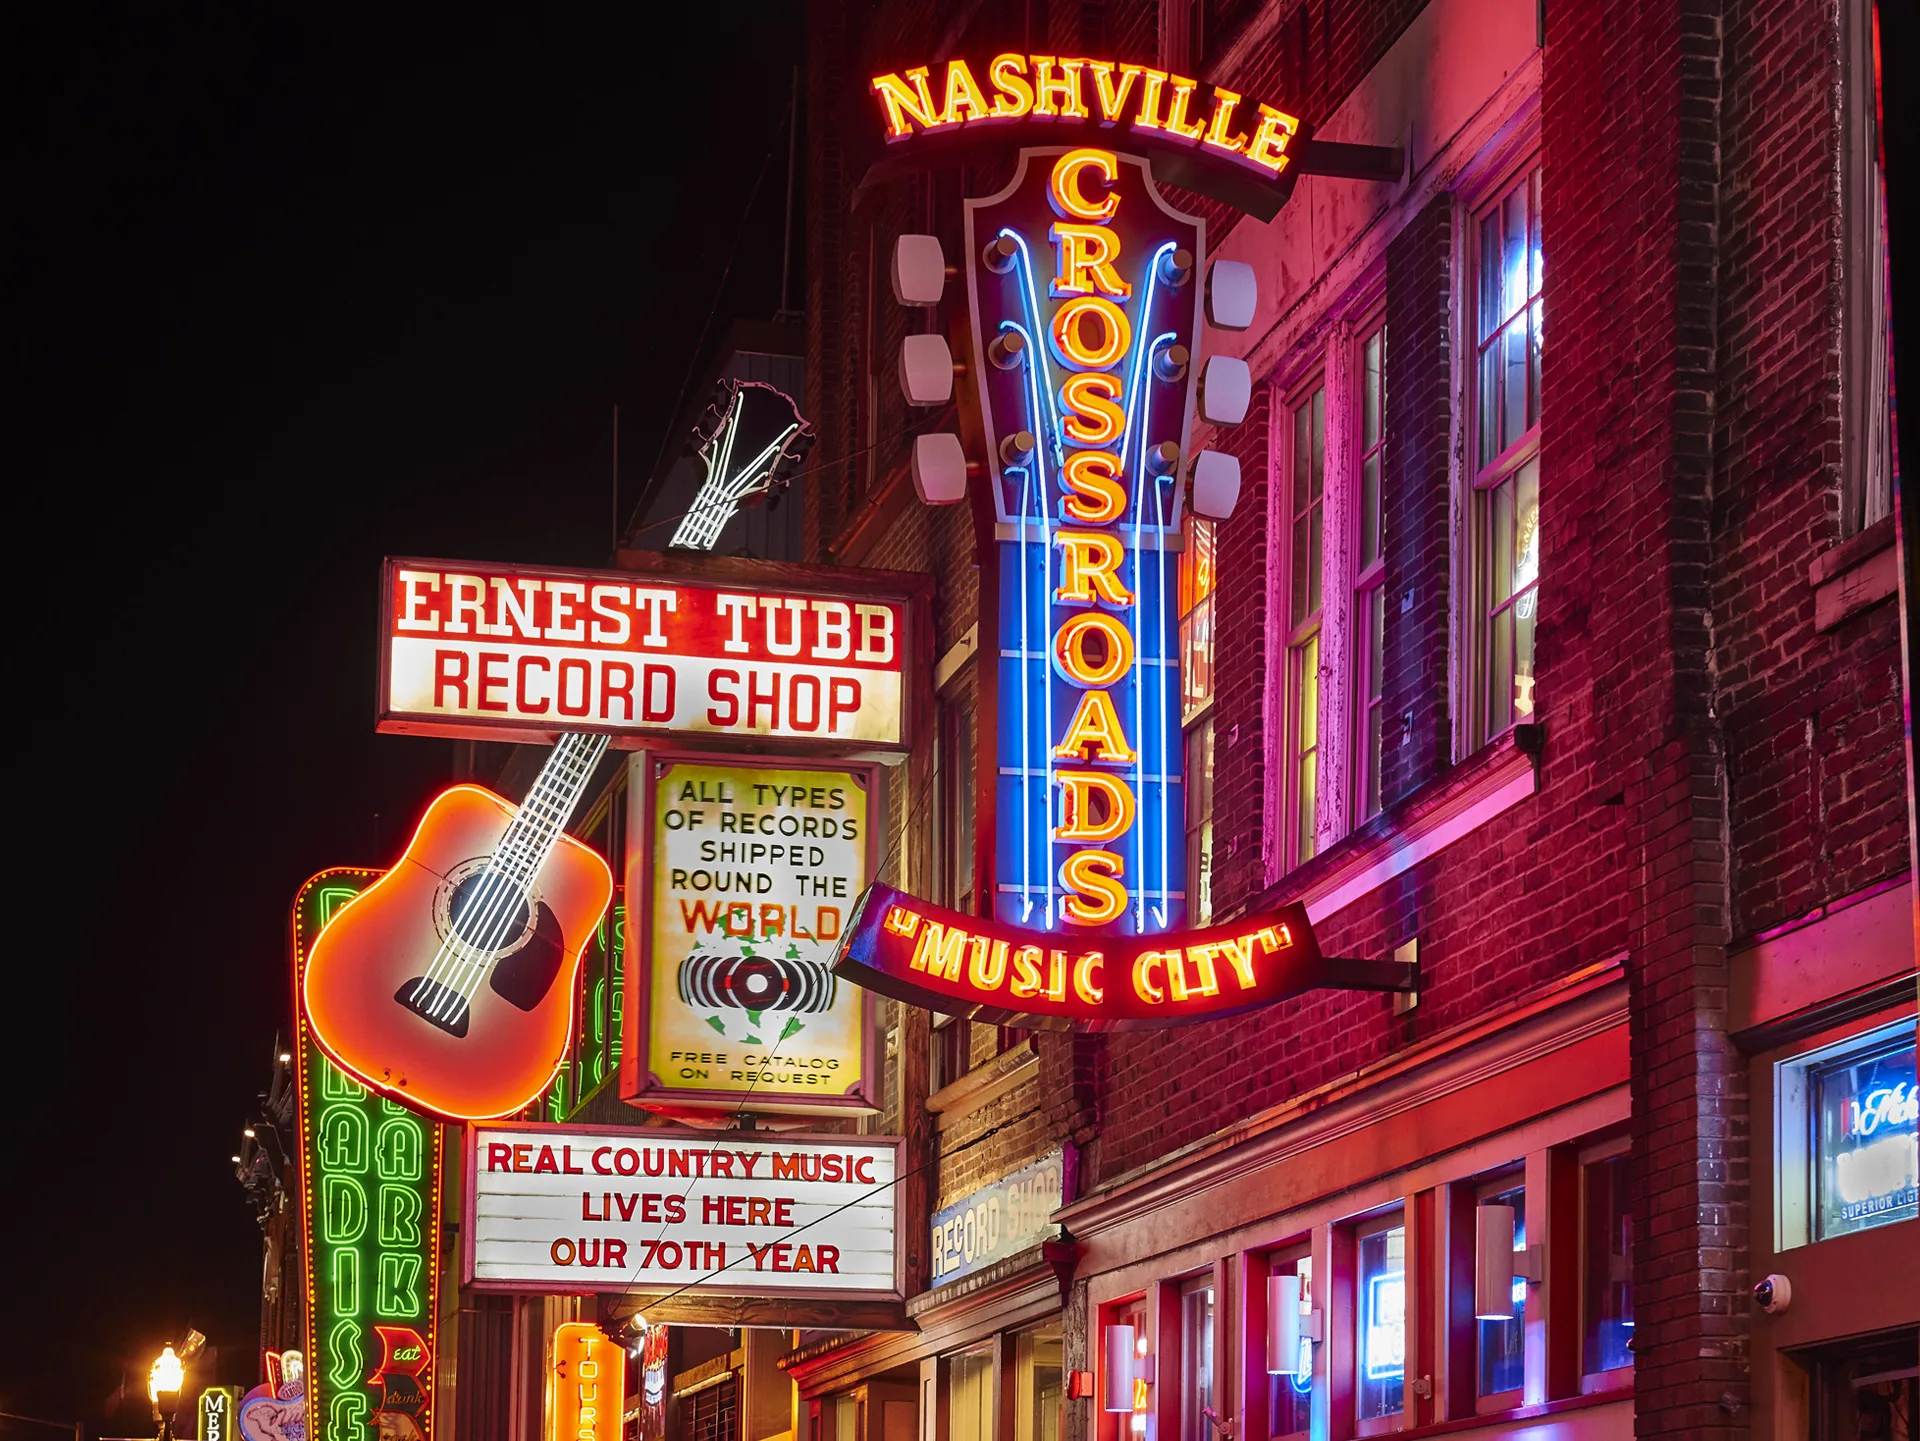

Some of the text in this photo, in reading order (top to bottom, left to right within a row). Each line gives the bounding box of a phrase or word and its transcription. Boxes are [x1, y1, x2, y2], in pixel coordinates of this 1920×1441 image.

[870, 53, 1299, 178] NASHVILLE
[1048, 148, 1136, 926] CROSSROADS
[398, 570, 895, 663] ERNEST TUBB
[434, 649, 862, 733] RECORD SHOP
[679, 780, 845, 810] ALL TYPES
[664, 809, 858, 841] OF RECORDS
[700, 840, 825, 867] SHIPPED
[672, 868, 848, 898] ROUND THE
[680, 899, 841, 941] WORLD
[670, 1051, 840, 1070] FREE CATALOG
[680, 1068, 831, 1085] ON REQUEST
[488, 1142, 876, 1184] REAL COUNTRY MUSIC
[375, 1097, 422, 1318] ARK
[582, 1191, 795, 1227] LIVES HERE
[932, 1166, 1059, 1279] RECORD SHOP
[1841, 1195, 1893, 1220] SUPERIOR
[550, 1237, 840, 1274] OUR 70TH YEAR
[393, 1345, 421, 1361] eat
[386, 1390, 425, 1405] drink
[579, 1338, 599, 1441] TOURS
